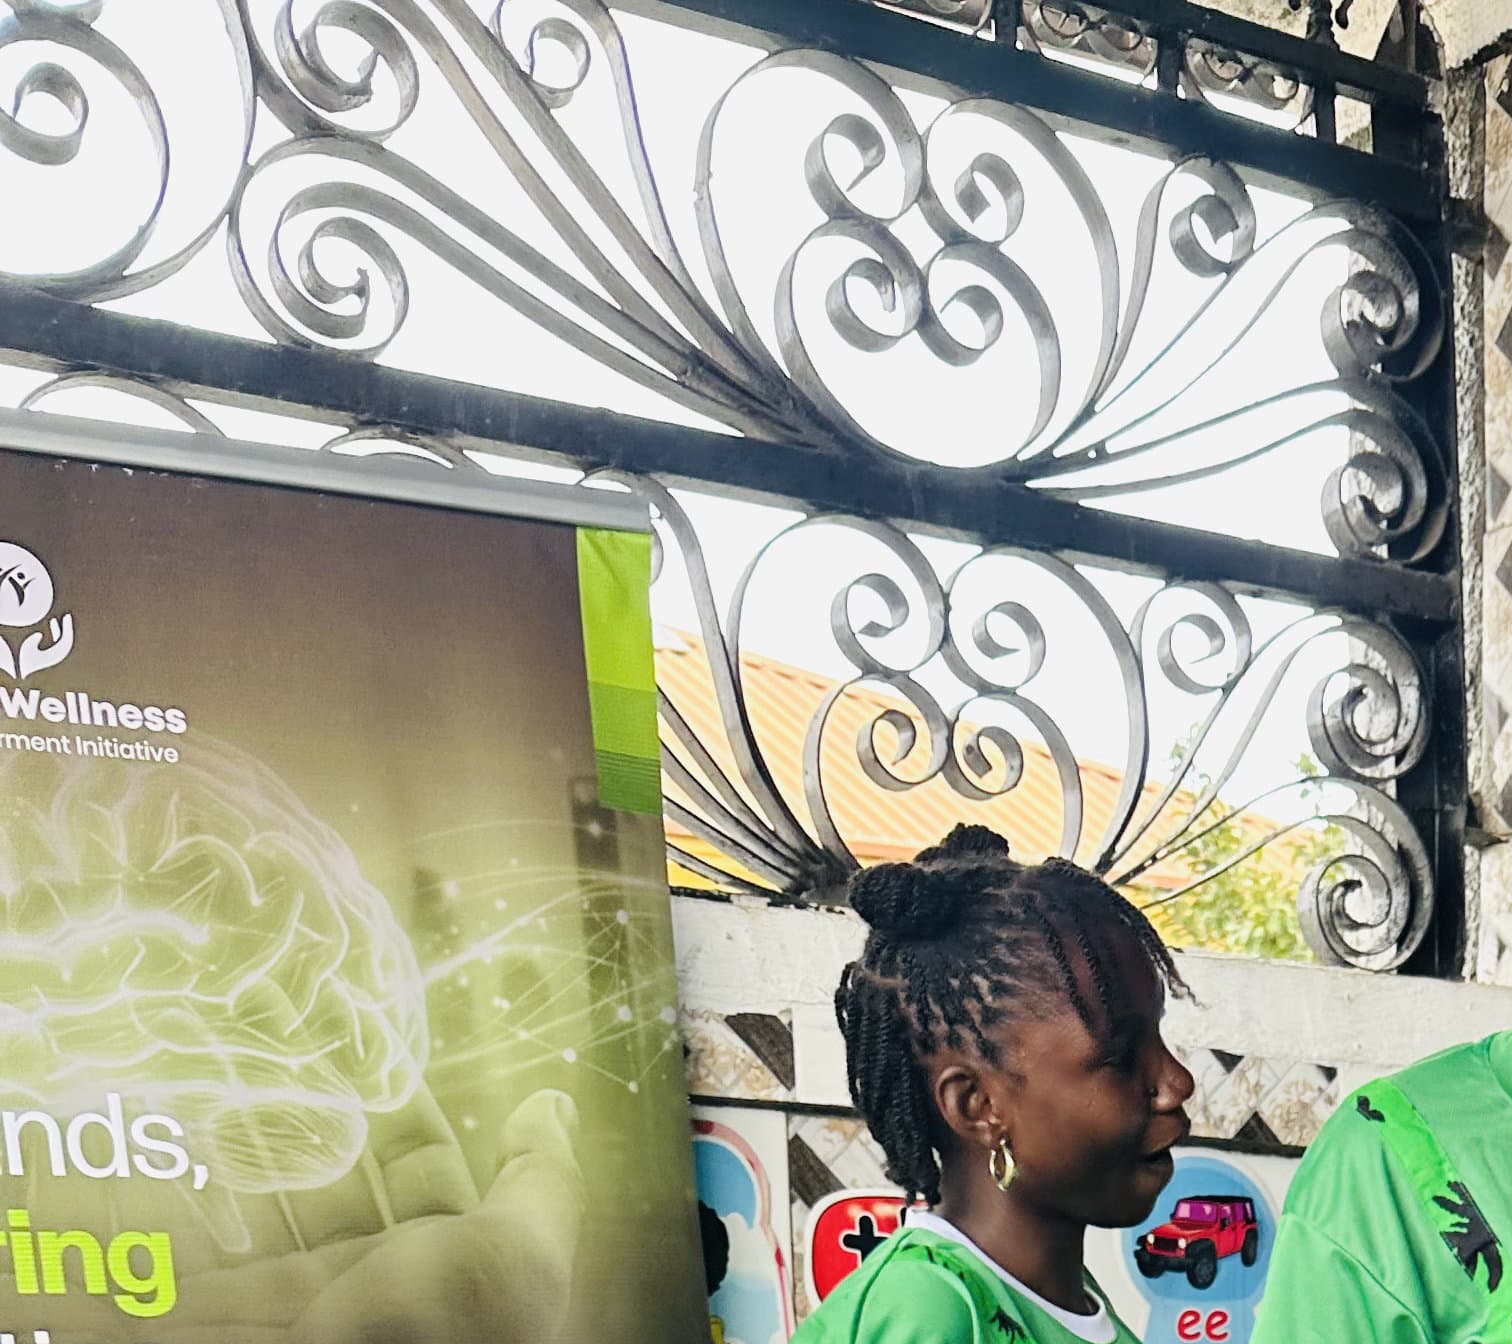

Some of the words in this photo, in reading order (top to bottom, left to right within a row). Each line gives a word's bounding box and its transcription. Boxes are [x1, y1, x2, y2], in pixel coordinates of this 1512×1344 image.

[0, 687, 187, 734] Wellness
[75, 736, 180, 763] Initiative
[1176, 1309, 1229, 1342] ee
